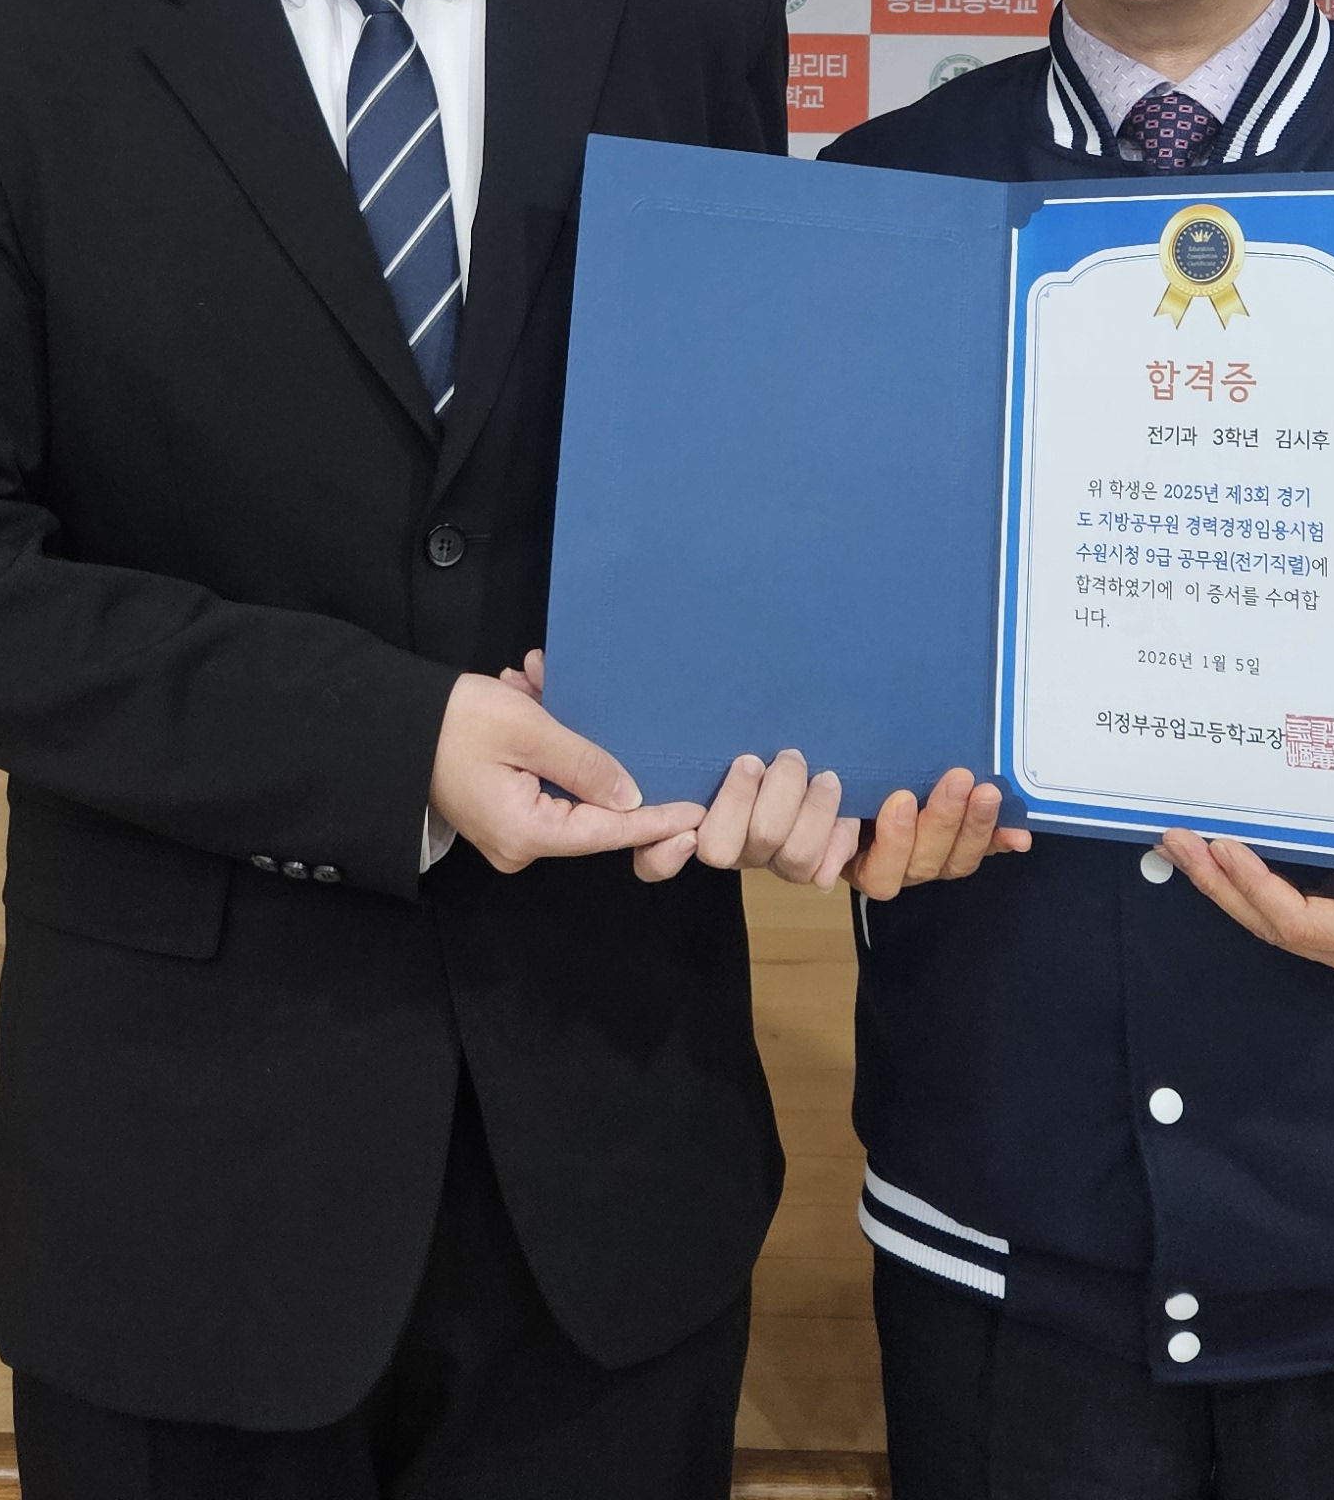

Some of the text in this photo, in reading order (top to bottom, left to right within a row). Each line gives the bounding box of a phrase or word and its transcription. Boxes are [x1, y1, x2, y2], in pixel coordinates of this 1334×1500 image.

[1145, 359, 1257, 403] 합격증
[1147, 425, 1330, 451] 전기과 3학년 김시후
[1087, 478, 1310, 509] 위 학생은 2025년 제3회 경기
[1076, 511, 1324, 543] 도 지방공무원 경력경쟁임용시험
[1075, 542, 1328, 578] 수원시청 9급 공무원(전기직렬)에
[1075, 574, 1320, 611] 합격하였기에 이 증서를 수여합
[1075, 606, 1110, 629] 니다.
[1138, 649, 1260, 676] 2026년 1월 5일
[1095, 710, 1288, 750] 의정부공업고등학교장
